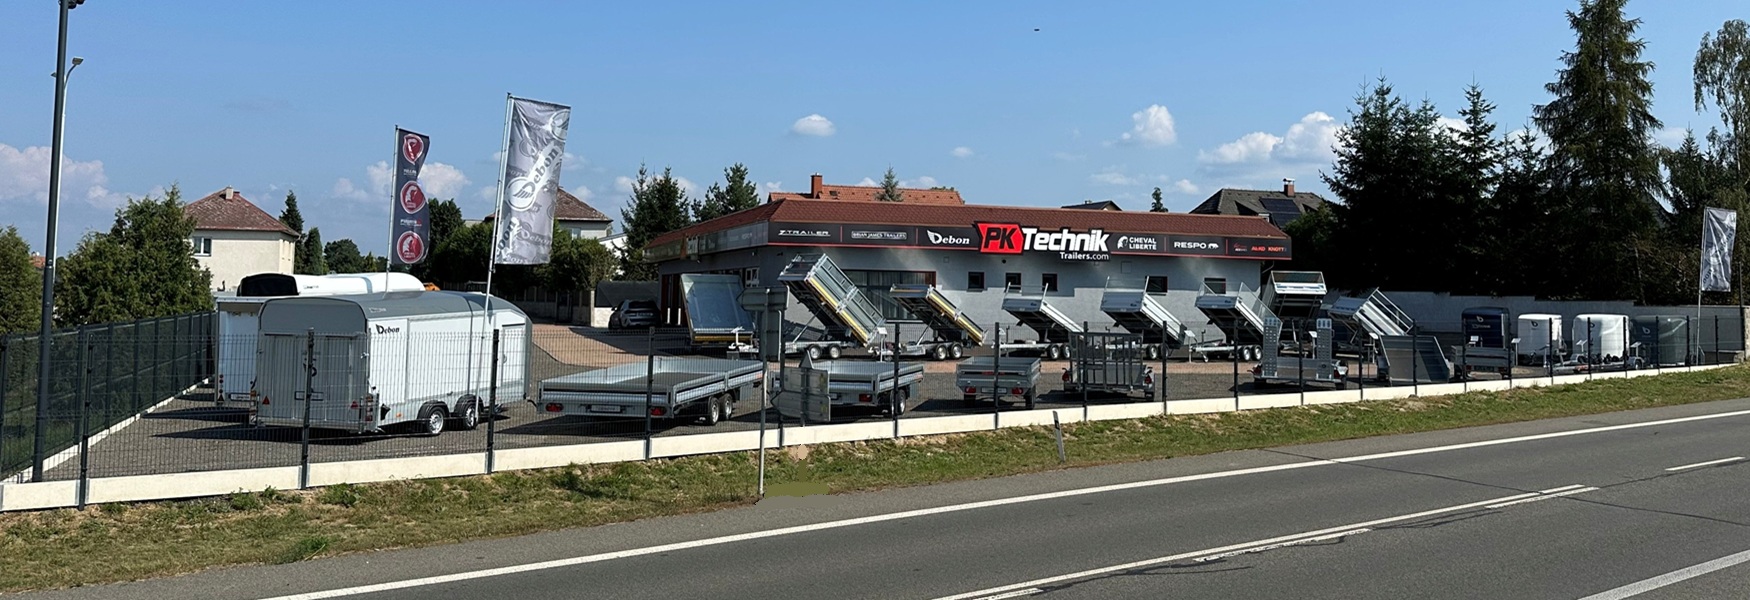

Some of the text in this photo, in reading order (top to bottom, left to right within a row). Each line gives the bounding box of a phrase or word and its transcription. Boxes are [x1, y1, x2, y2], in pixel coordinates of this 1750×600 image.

[513, 147, 559, 198] Debon
[927, 230, 970, 245] Debon
[983, 227, 1110, 252] PK Technik
[1173, 241, 1207, 249] RESPO
[1060, 251, 1109, 260] Trailers.com
[375, 324, 400, 334] Debon
